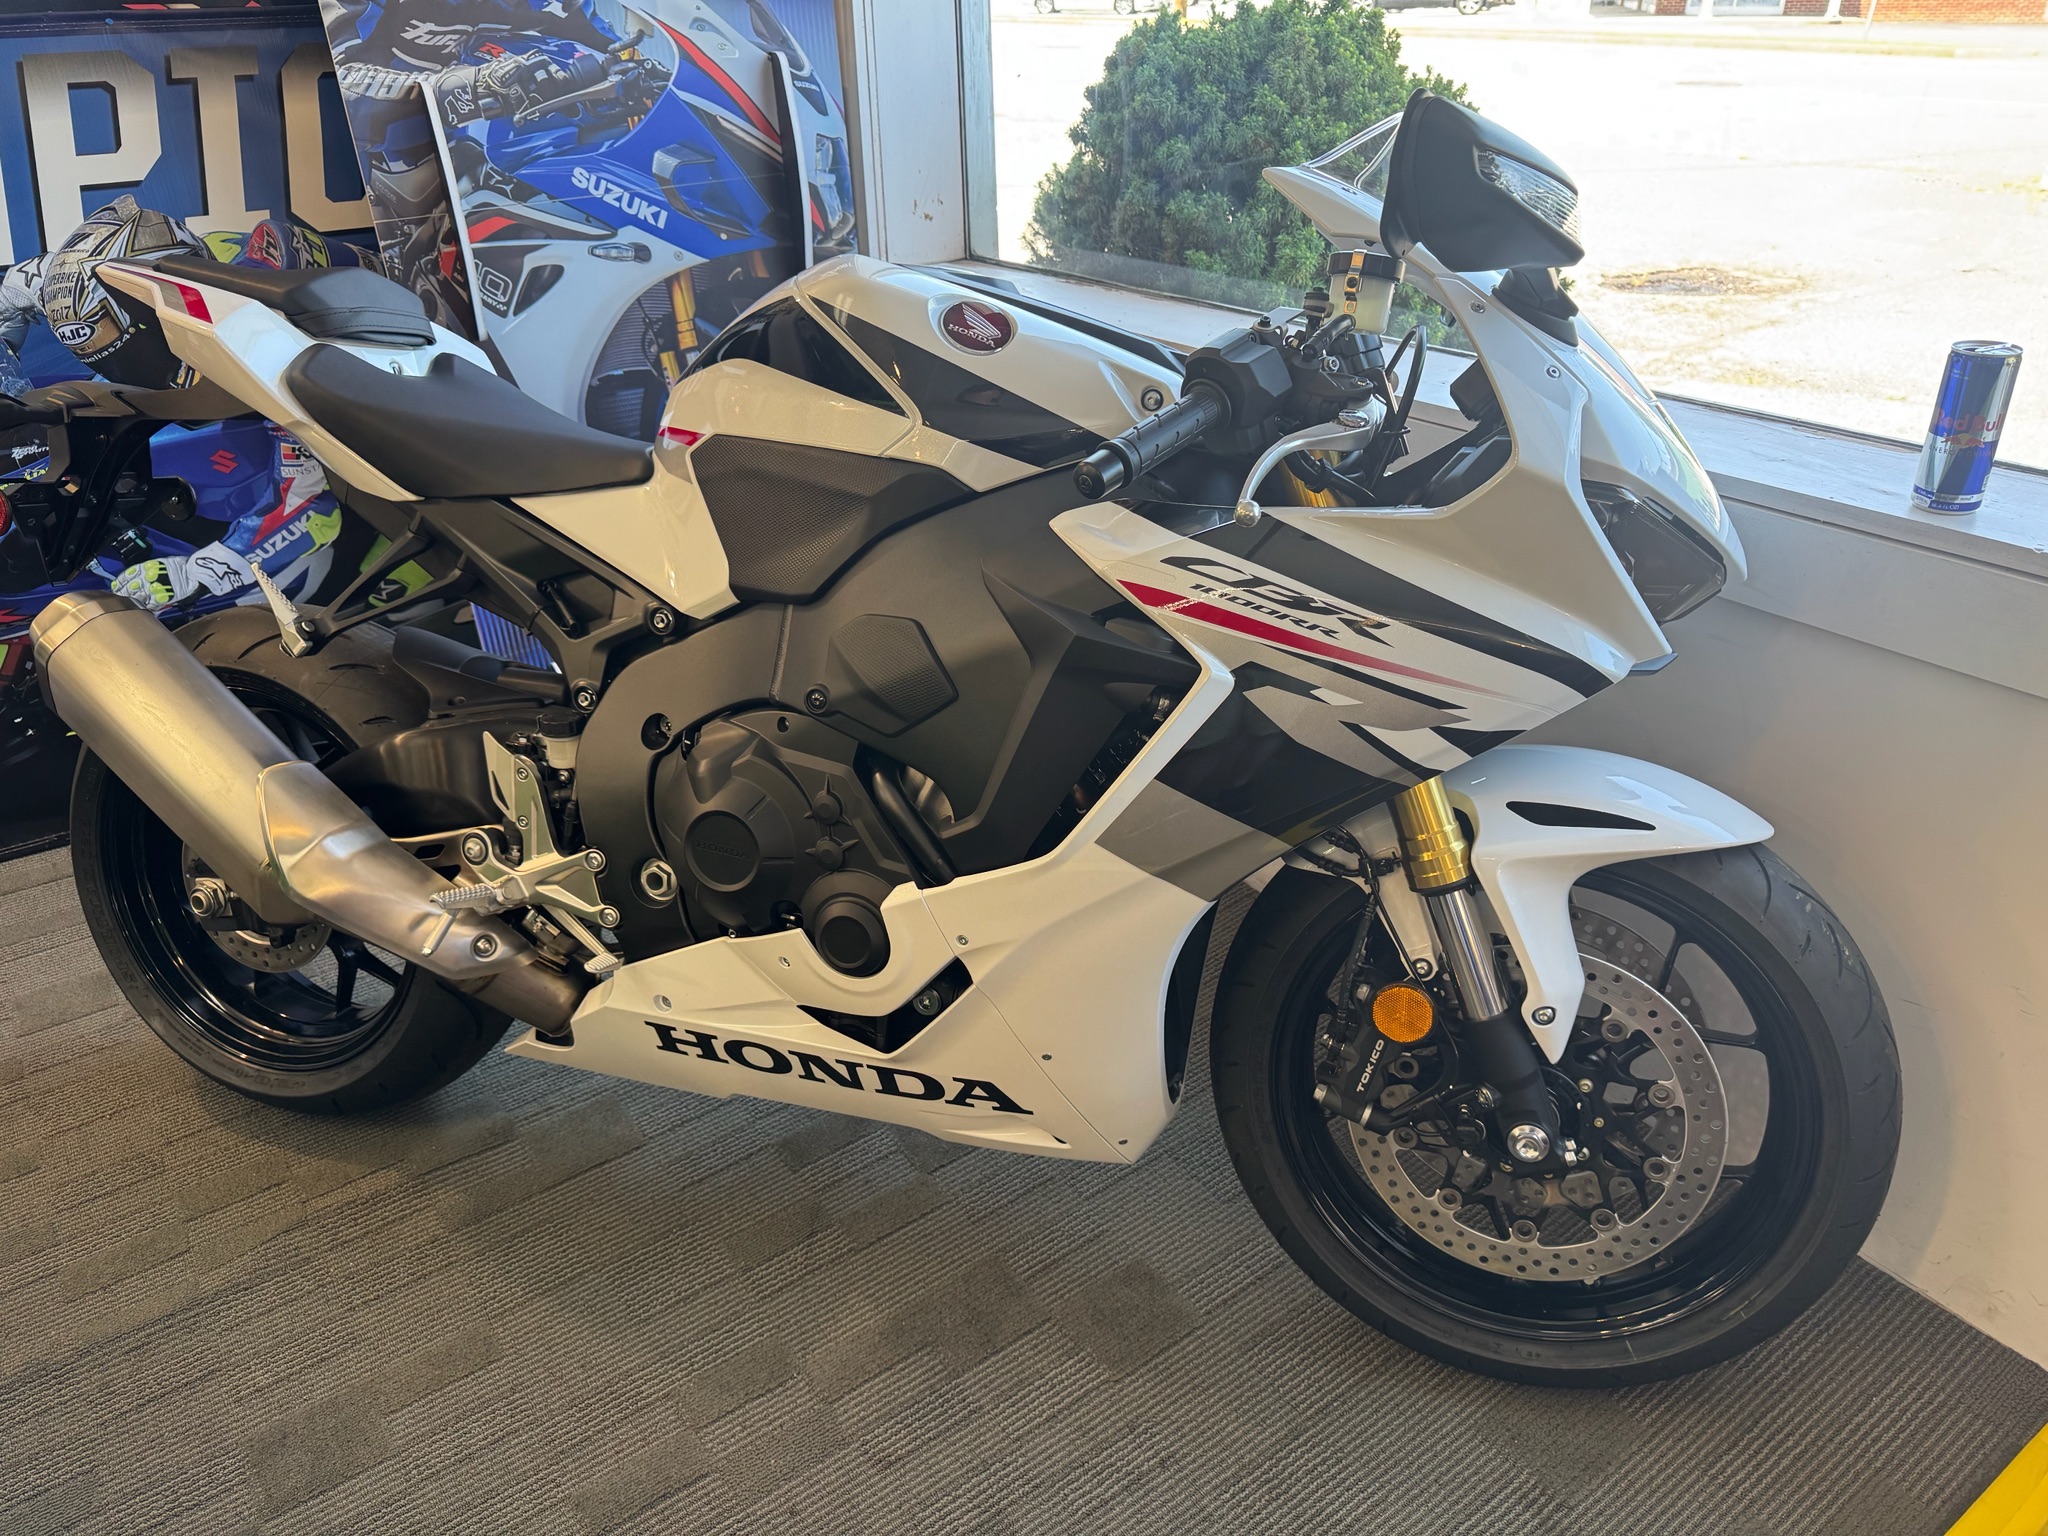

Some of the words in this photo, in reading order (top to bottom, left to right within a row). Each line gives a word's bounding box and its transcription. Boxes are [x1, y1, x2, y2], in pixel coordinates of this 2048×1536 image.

[571, 167, 668, 229] SUZUKI
[50, 305, 72, 323] 2017
[59, 325, 87, 343] HJC
[947, 323, 996, 348] HONDA
[1935, 407, 1970, 431] Red
[1159, 556, 1395, 648] CBR
[1189, 583, 1341, 640] 1000RR
[644, 1020, 1034, 1116] HONDA
[1356, 1039, 1385, 1093] TOKICO
